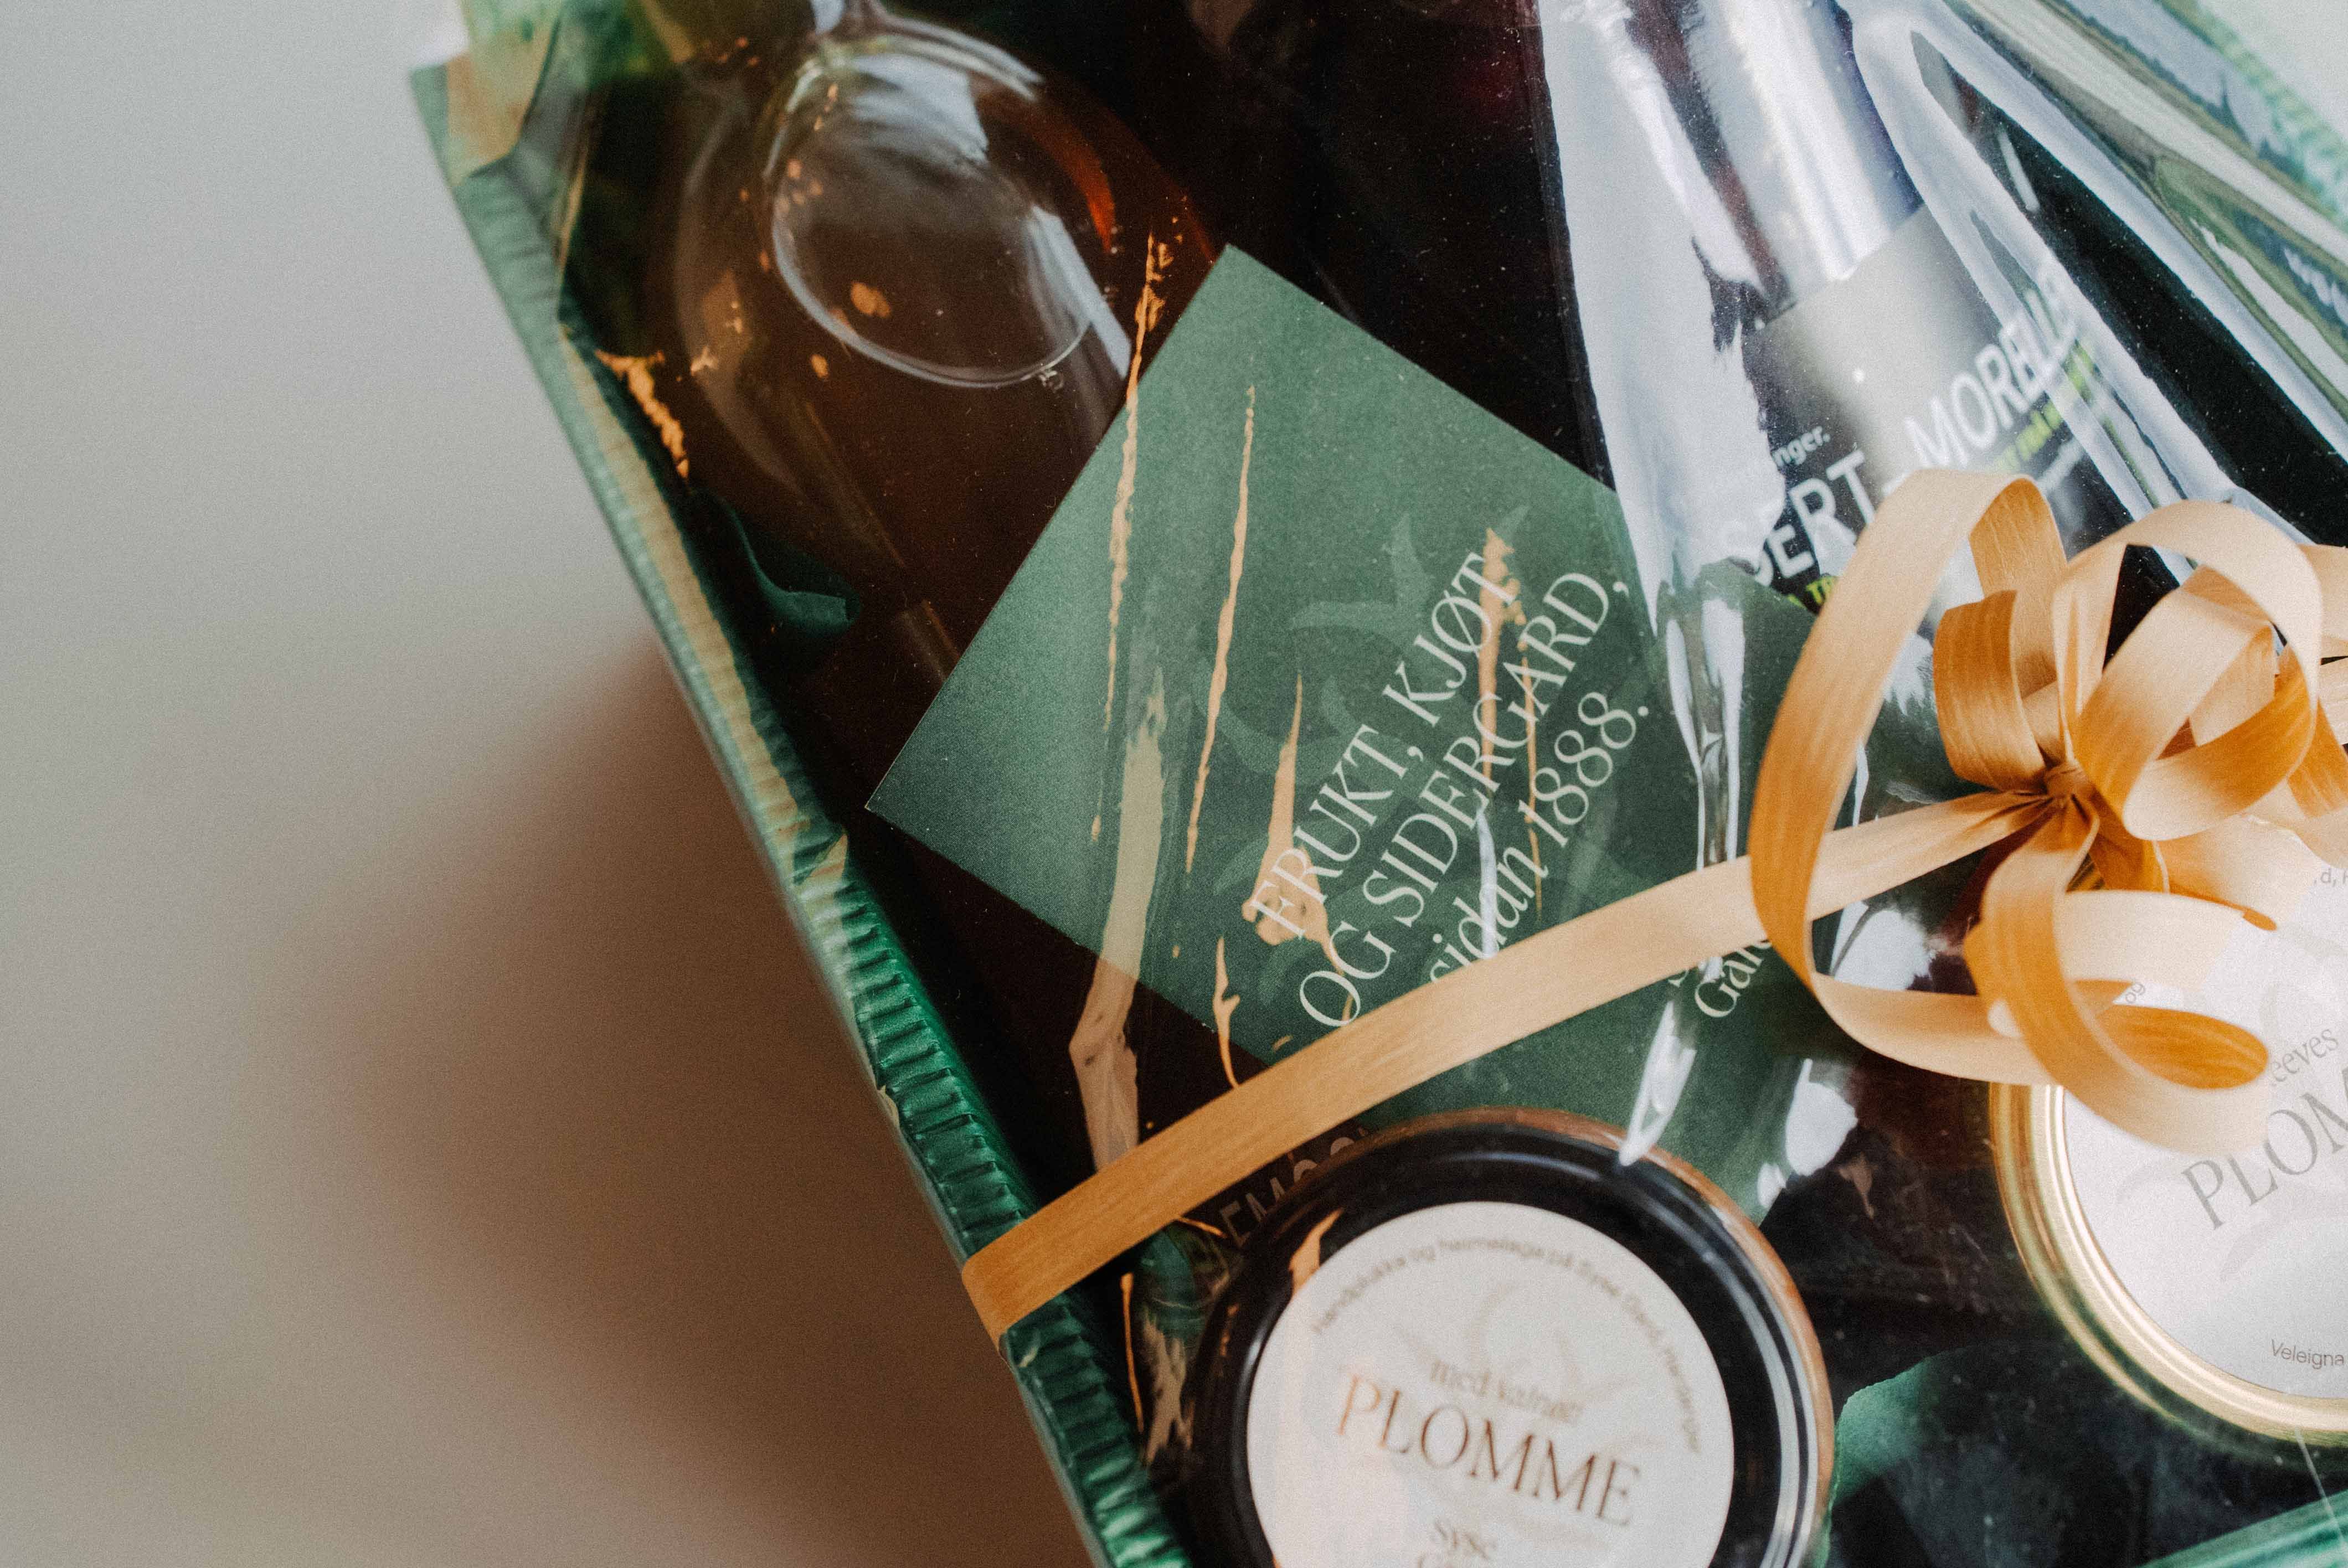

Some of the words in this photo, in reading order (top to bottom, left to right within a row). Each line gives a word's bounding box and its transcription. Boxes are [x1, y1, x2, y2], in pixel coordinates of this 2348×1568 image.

[1249, 724, 1424, 939] FRUKT,
[1382, 552, 1518, 728] KJØT
[1299, 920, 1397, 1027] OG
[1363, 571, 1630, 927] SIDERGARD,
[1518, 691, 1649, 848] 1888.
[2271, 1338, 2345, 1369] Veleigna
[1336, 1375, 1641, 1526] PLOMME
